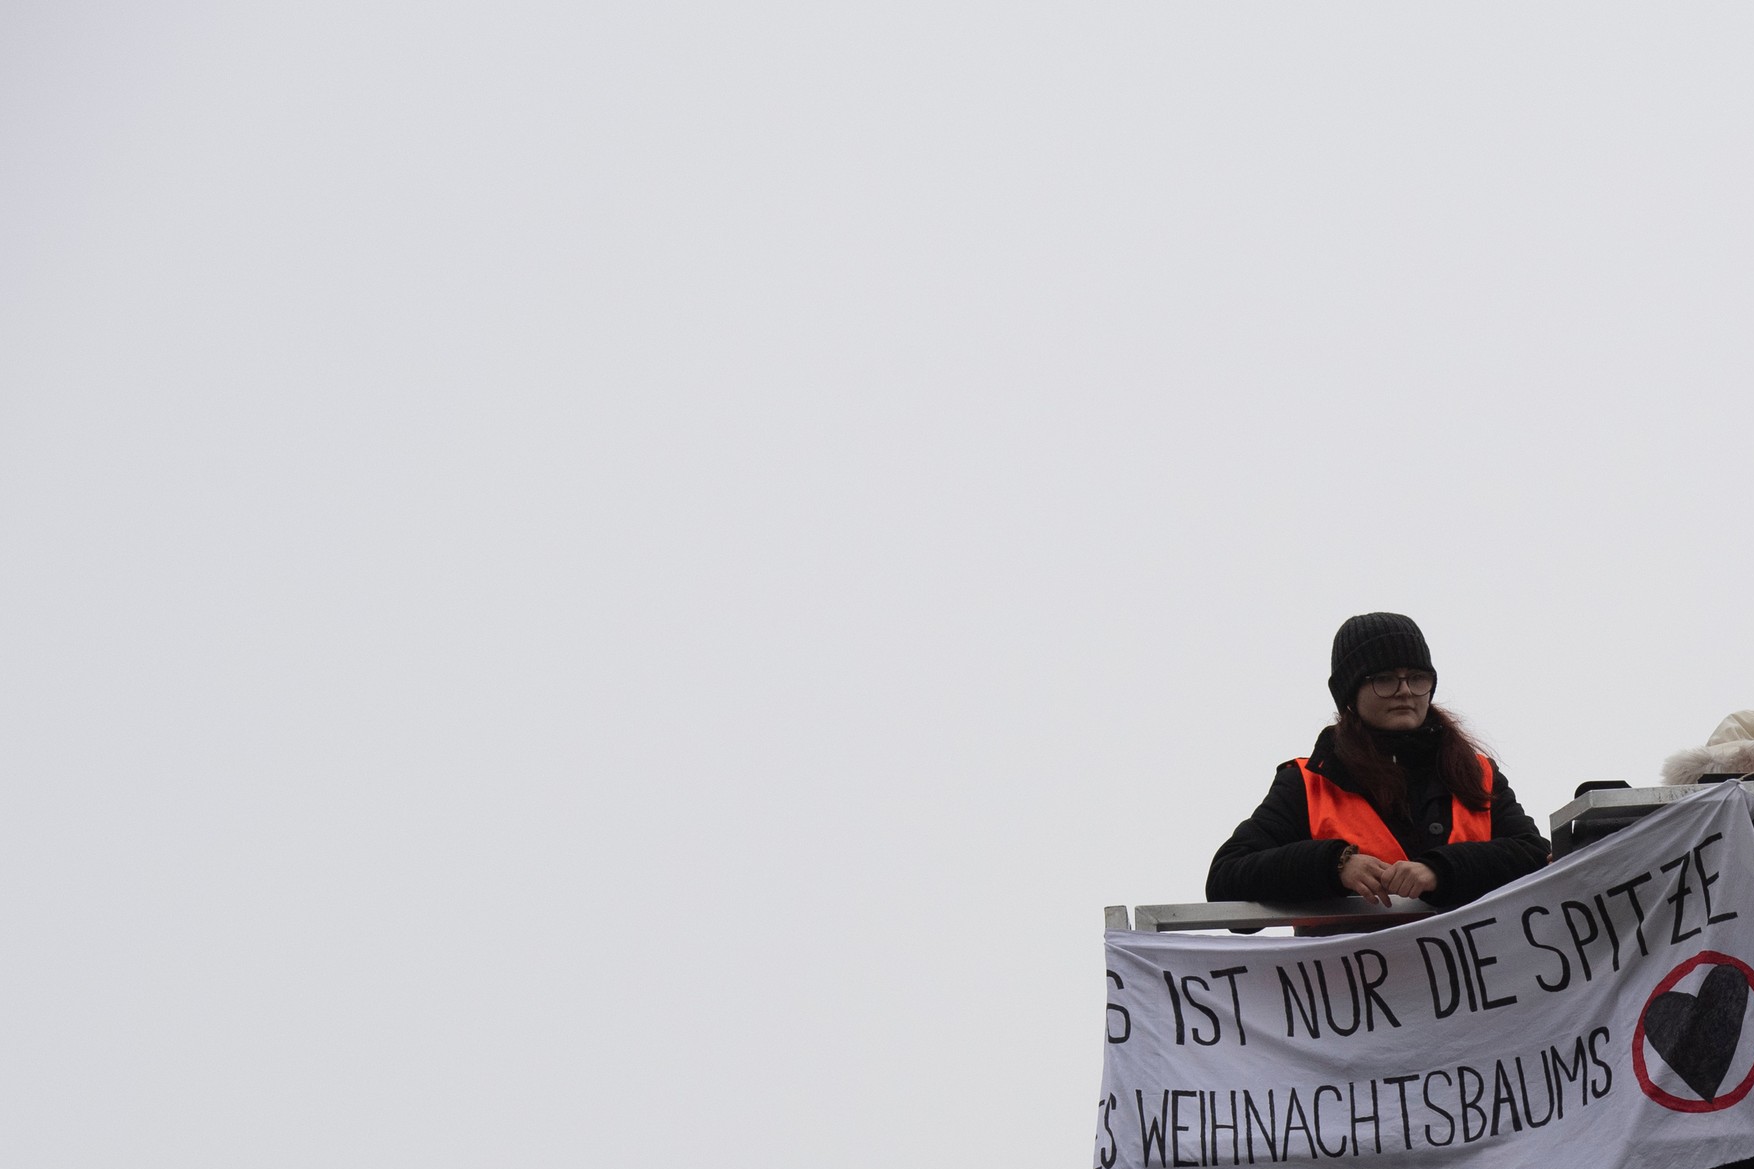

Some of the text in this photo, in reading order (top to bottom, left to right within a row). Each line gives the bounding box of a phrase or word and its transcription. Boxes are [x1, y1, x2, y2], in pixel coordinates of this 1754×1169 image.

[1162, 966, 1249, 1046] IST
[1276, 948, 1402, 1039] NUR
[1417, 917, 1518, 1020] DIE
[1521, 833, 1738, 992] SPITZE
[1135, 1026, 1613, 1168] WEIHNACHTSBAUMS
